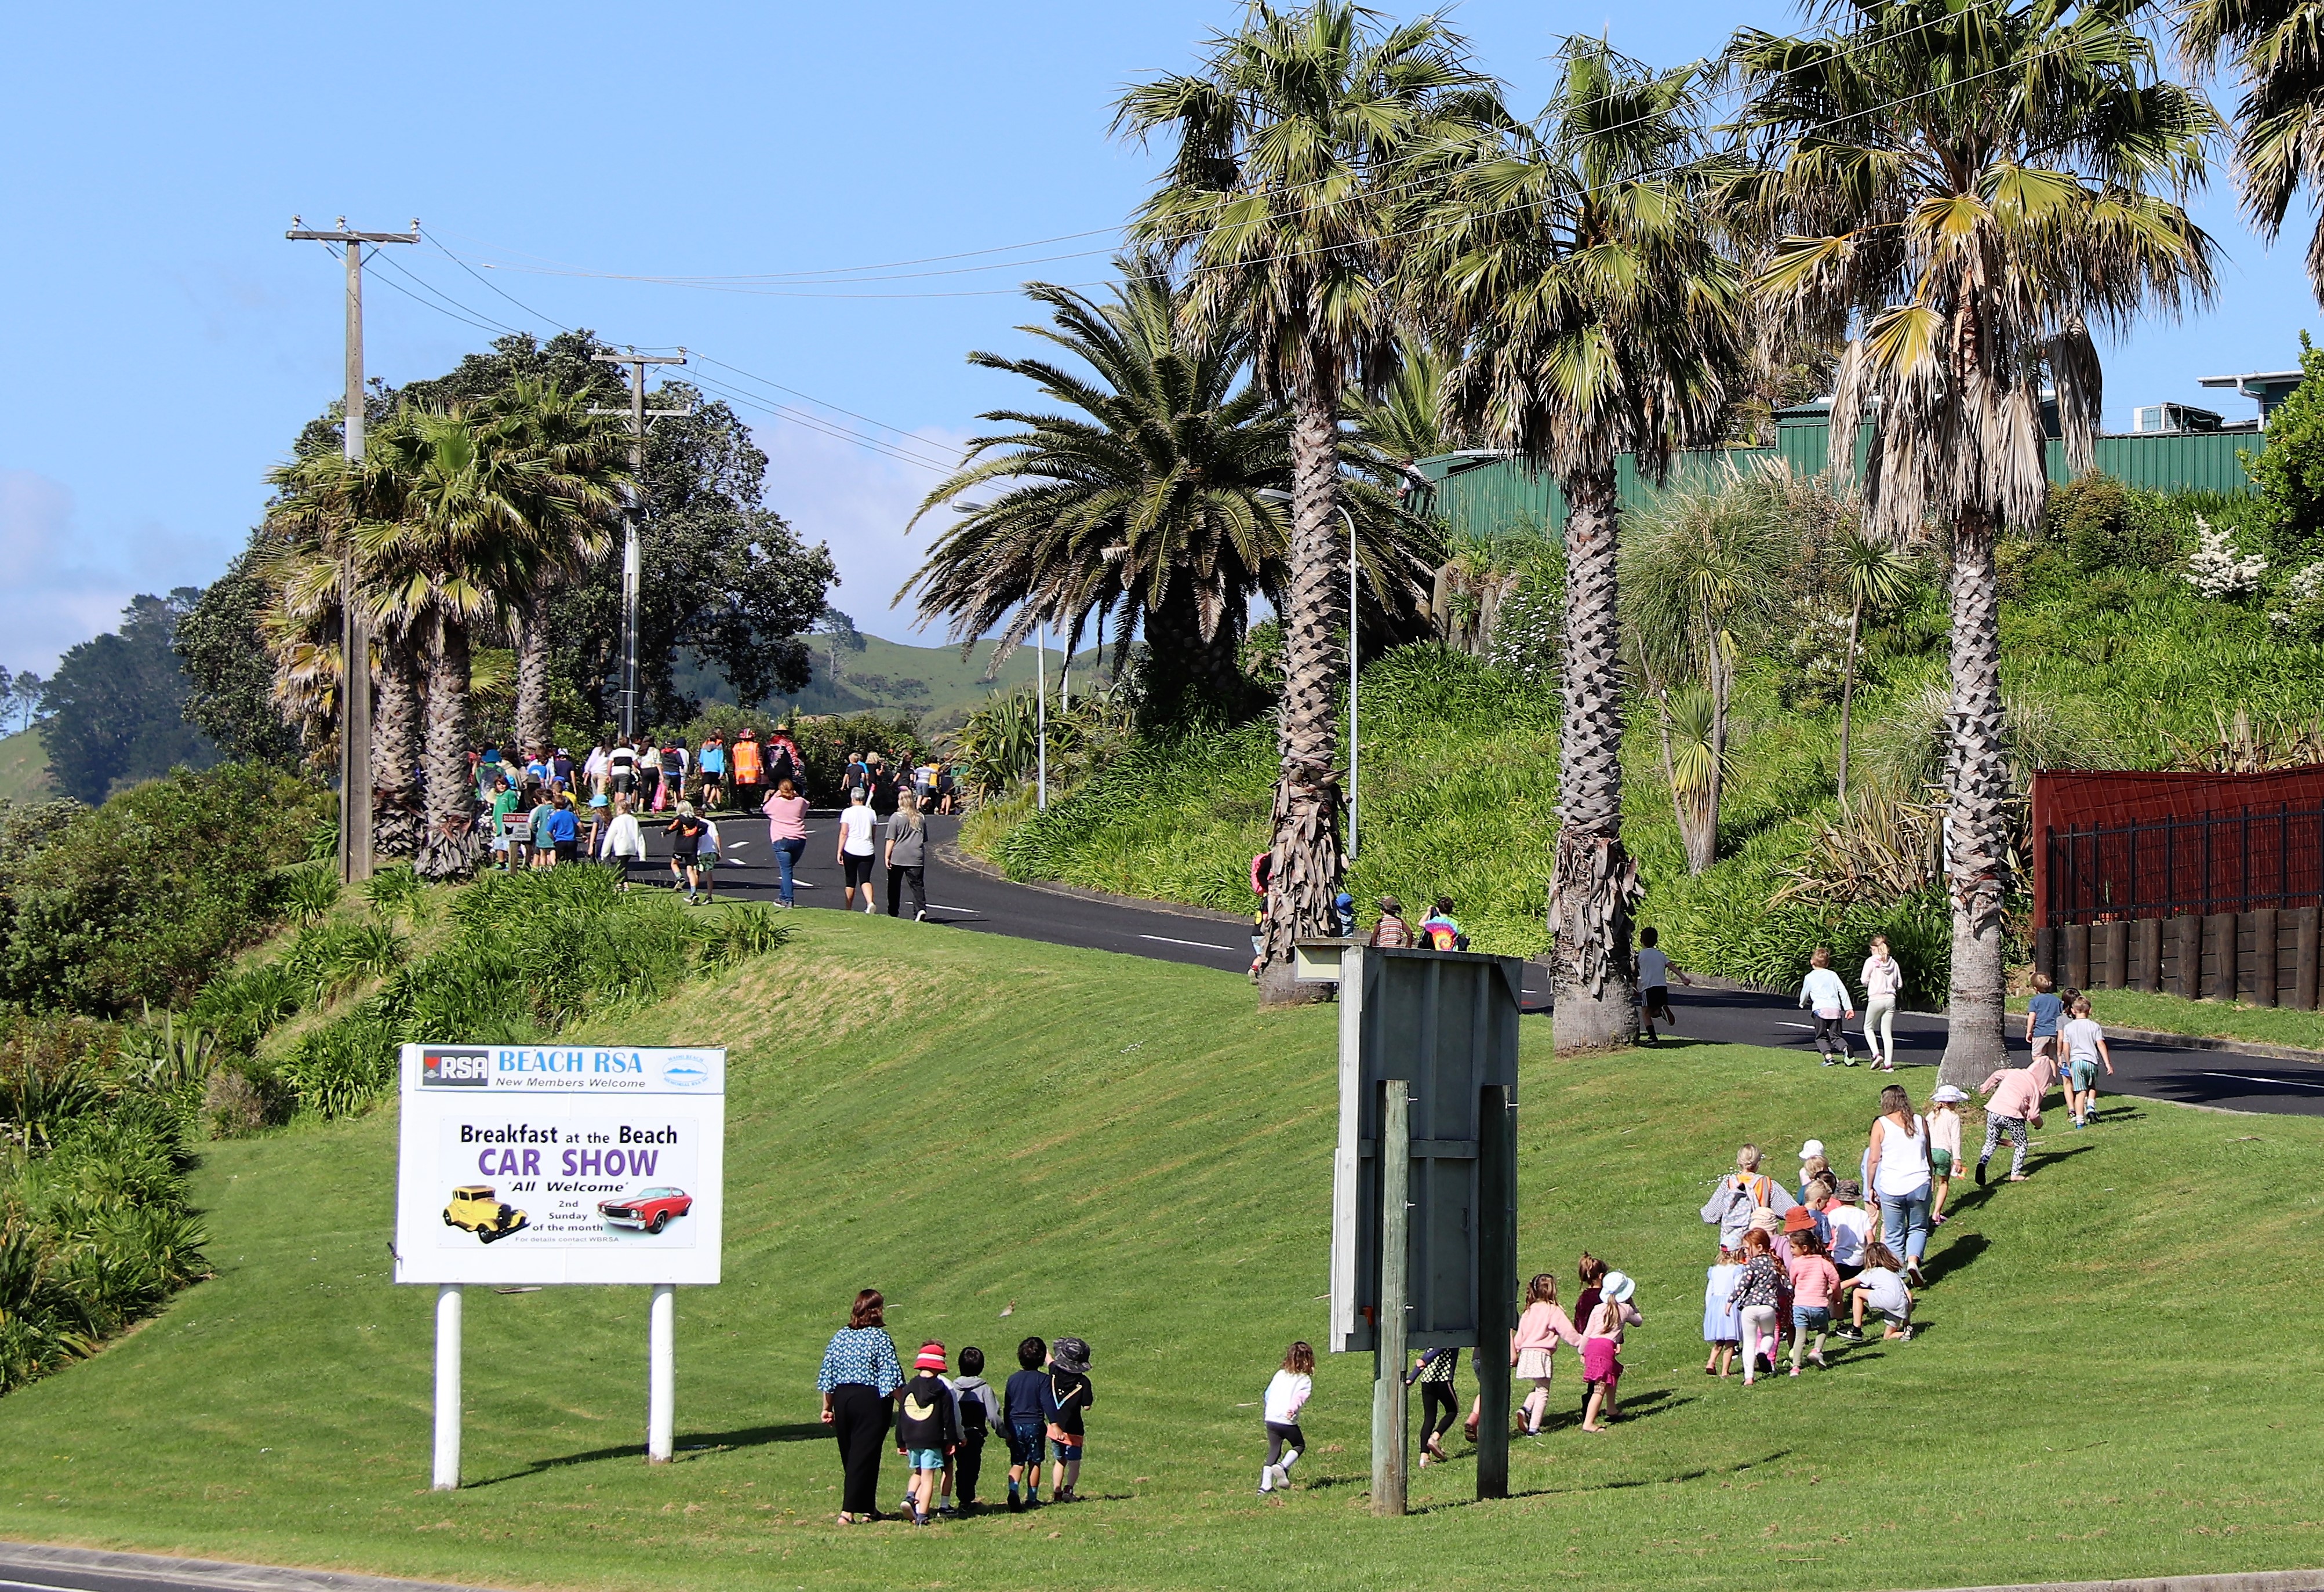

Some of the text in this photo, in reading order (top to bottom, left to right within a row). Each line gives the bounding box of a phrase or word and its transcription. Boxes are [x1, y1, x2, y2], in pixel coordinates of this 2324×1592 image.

[441, 1057, 488, 1079] RSA
[499, 1051, 642, 1073] BEACH RSA
[496, 1078, 646, 1088] New Members Welcome
[461, 1124, 678, 1144] Breakfast at the Beach
[478, 1148, 659, 1176] CAR SHOW
[549, 1212, 588, 1222] Sunday
